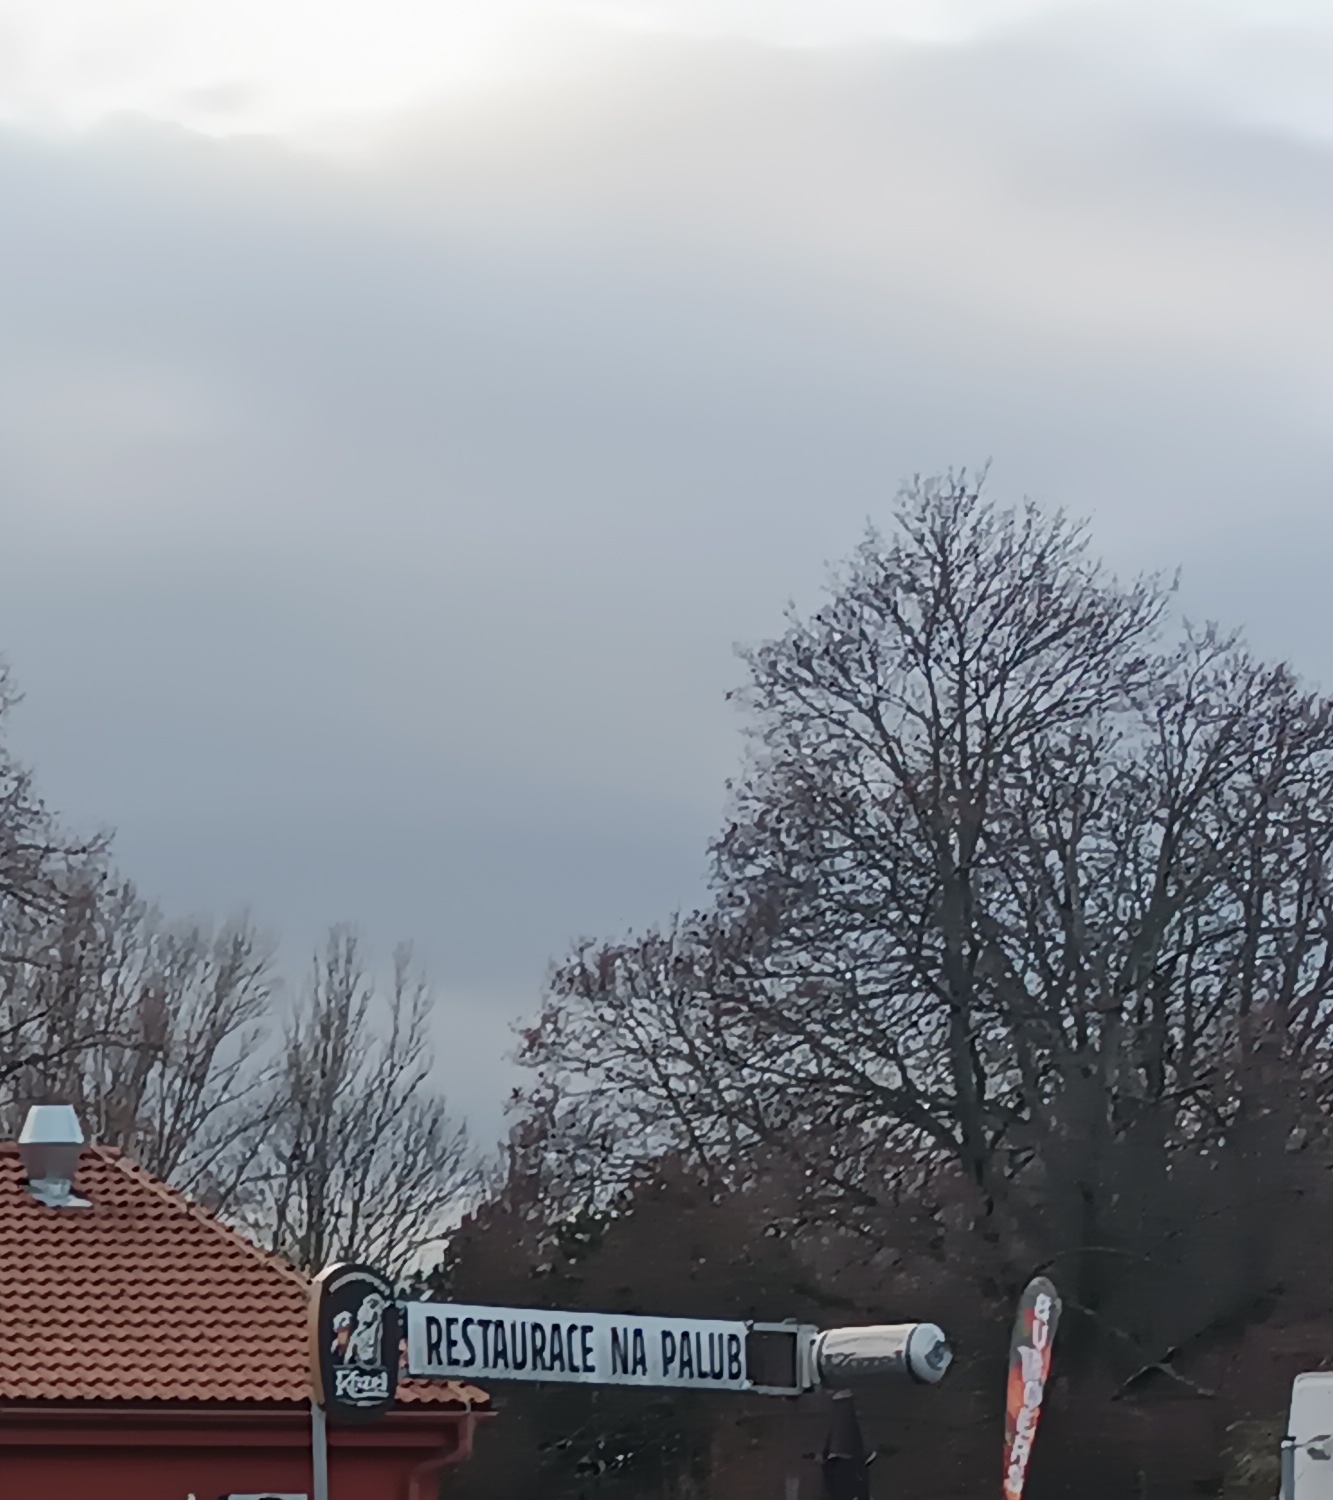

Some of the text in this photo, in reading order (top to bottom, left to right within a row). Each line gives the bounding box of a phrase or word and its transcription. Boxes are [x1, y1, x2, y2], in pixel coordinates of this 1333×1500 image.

[425, 1315, 742, 1381] RESTAURACE NA PALUB
